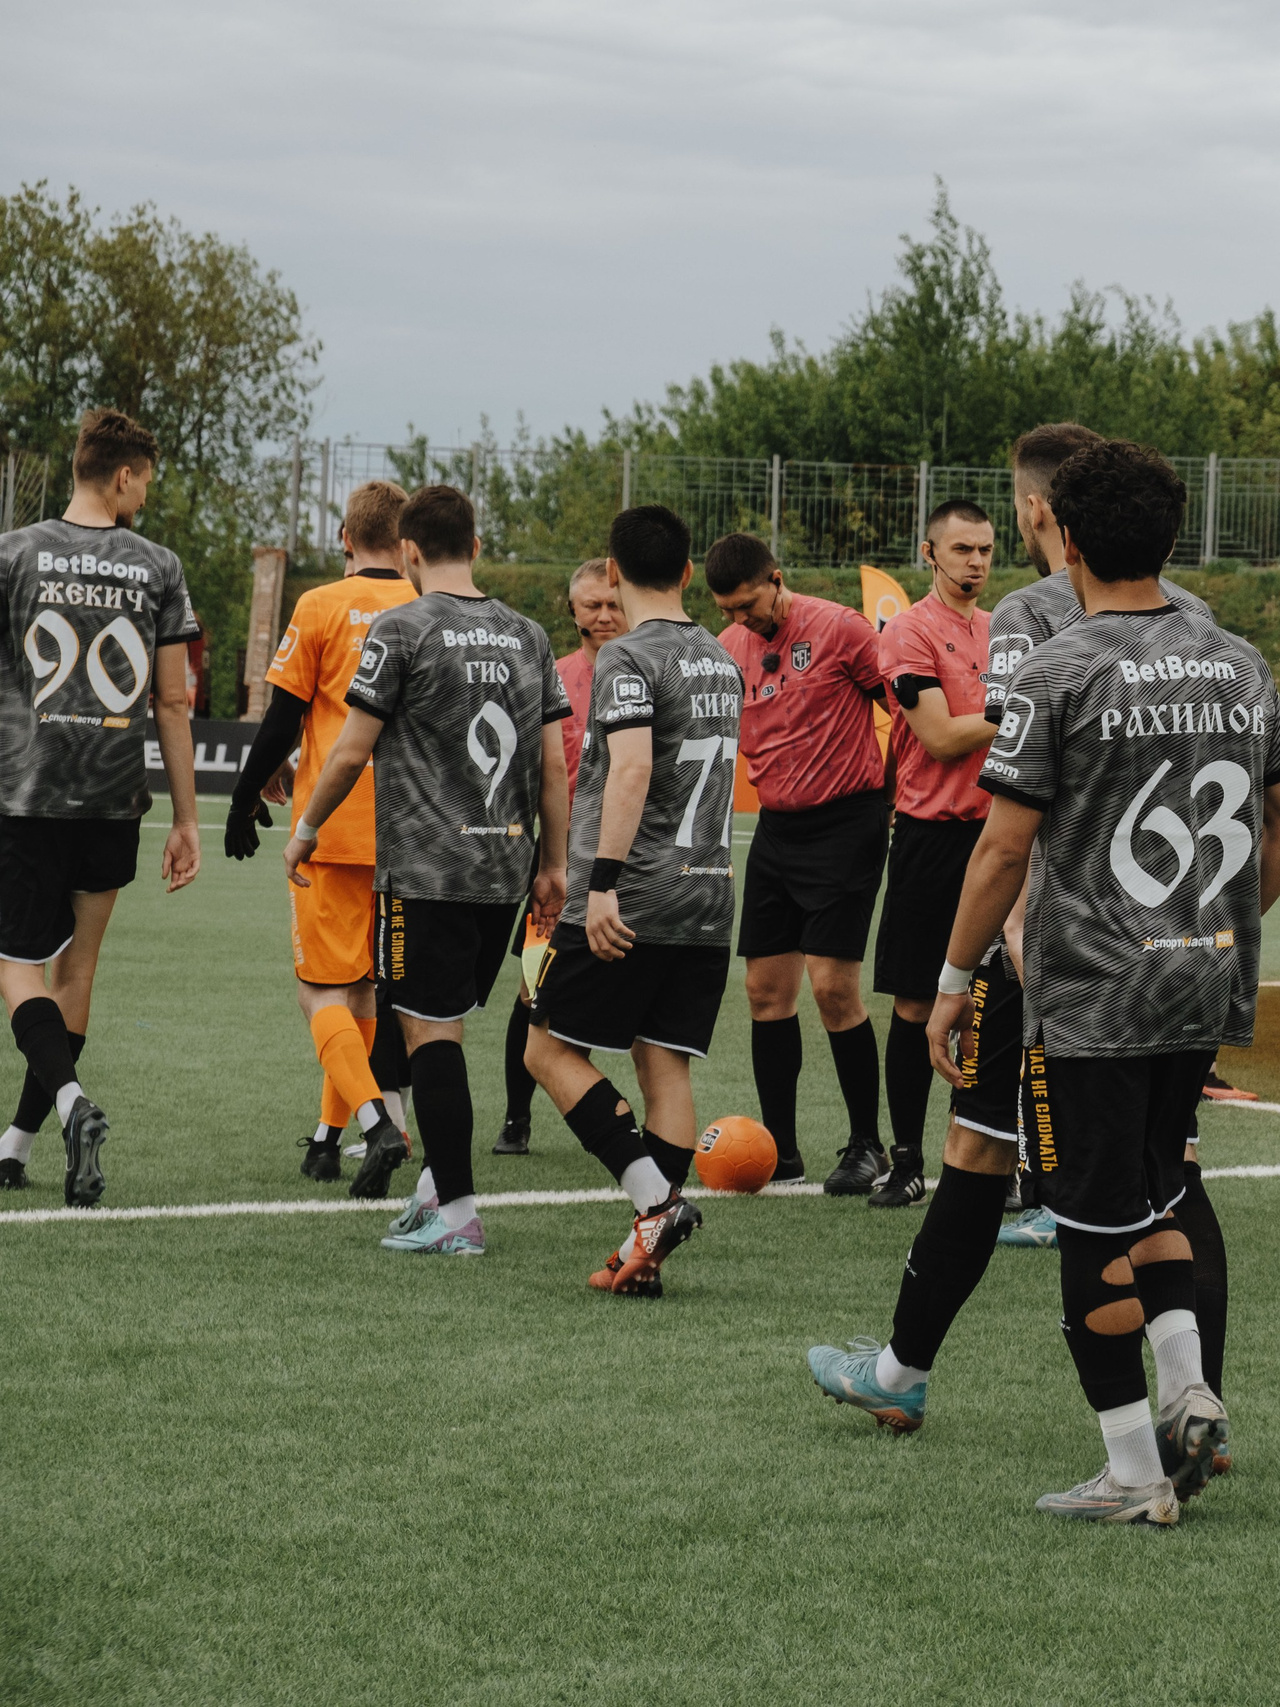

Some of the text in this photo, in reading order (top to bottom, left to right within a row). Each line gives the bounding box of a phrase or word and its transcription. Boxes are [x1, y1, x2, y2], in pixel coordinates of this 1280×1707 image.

[38, 552, 149, 583] BetBoom
[38, 580, 144, 612] ЖЕКИЧ
[442, 628, 521, 650] BetBoom
[24, 609, 149, 714] 90
[465, 661, 510, 684] ГИО
[679, 657, 739, 679] BetBoom
[1119, 656, 1236, 684] BetBoom
[620, 683, 640, 696] BB
[606, 704, 654, 720] BetBoom
[690, 692, 738, 719] КИРЯ
[1100, 702, 1265, 740] РАХИМОВ
[467, 700, 517, 808] 9
[675, 734, 738, 848] 77
[1109, 759, 1252, 909] 63
[391, 898, 405, 980] АС НЕ СЛОМАТЬ
[1216, 931, 1234, 947] PRO
[1031, 1080, 1047, 1098] НЕ
[1035, 1103, 1059, 1172] СЛОМАТЬ
[645, 1217, 667, 1254] adidas
